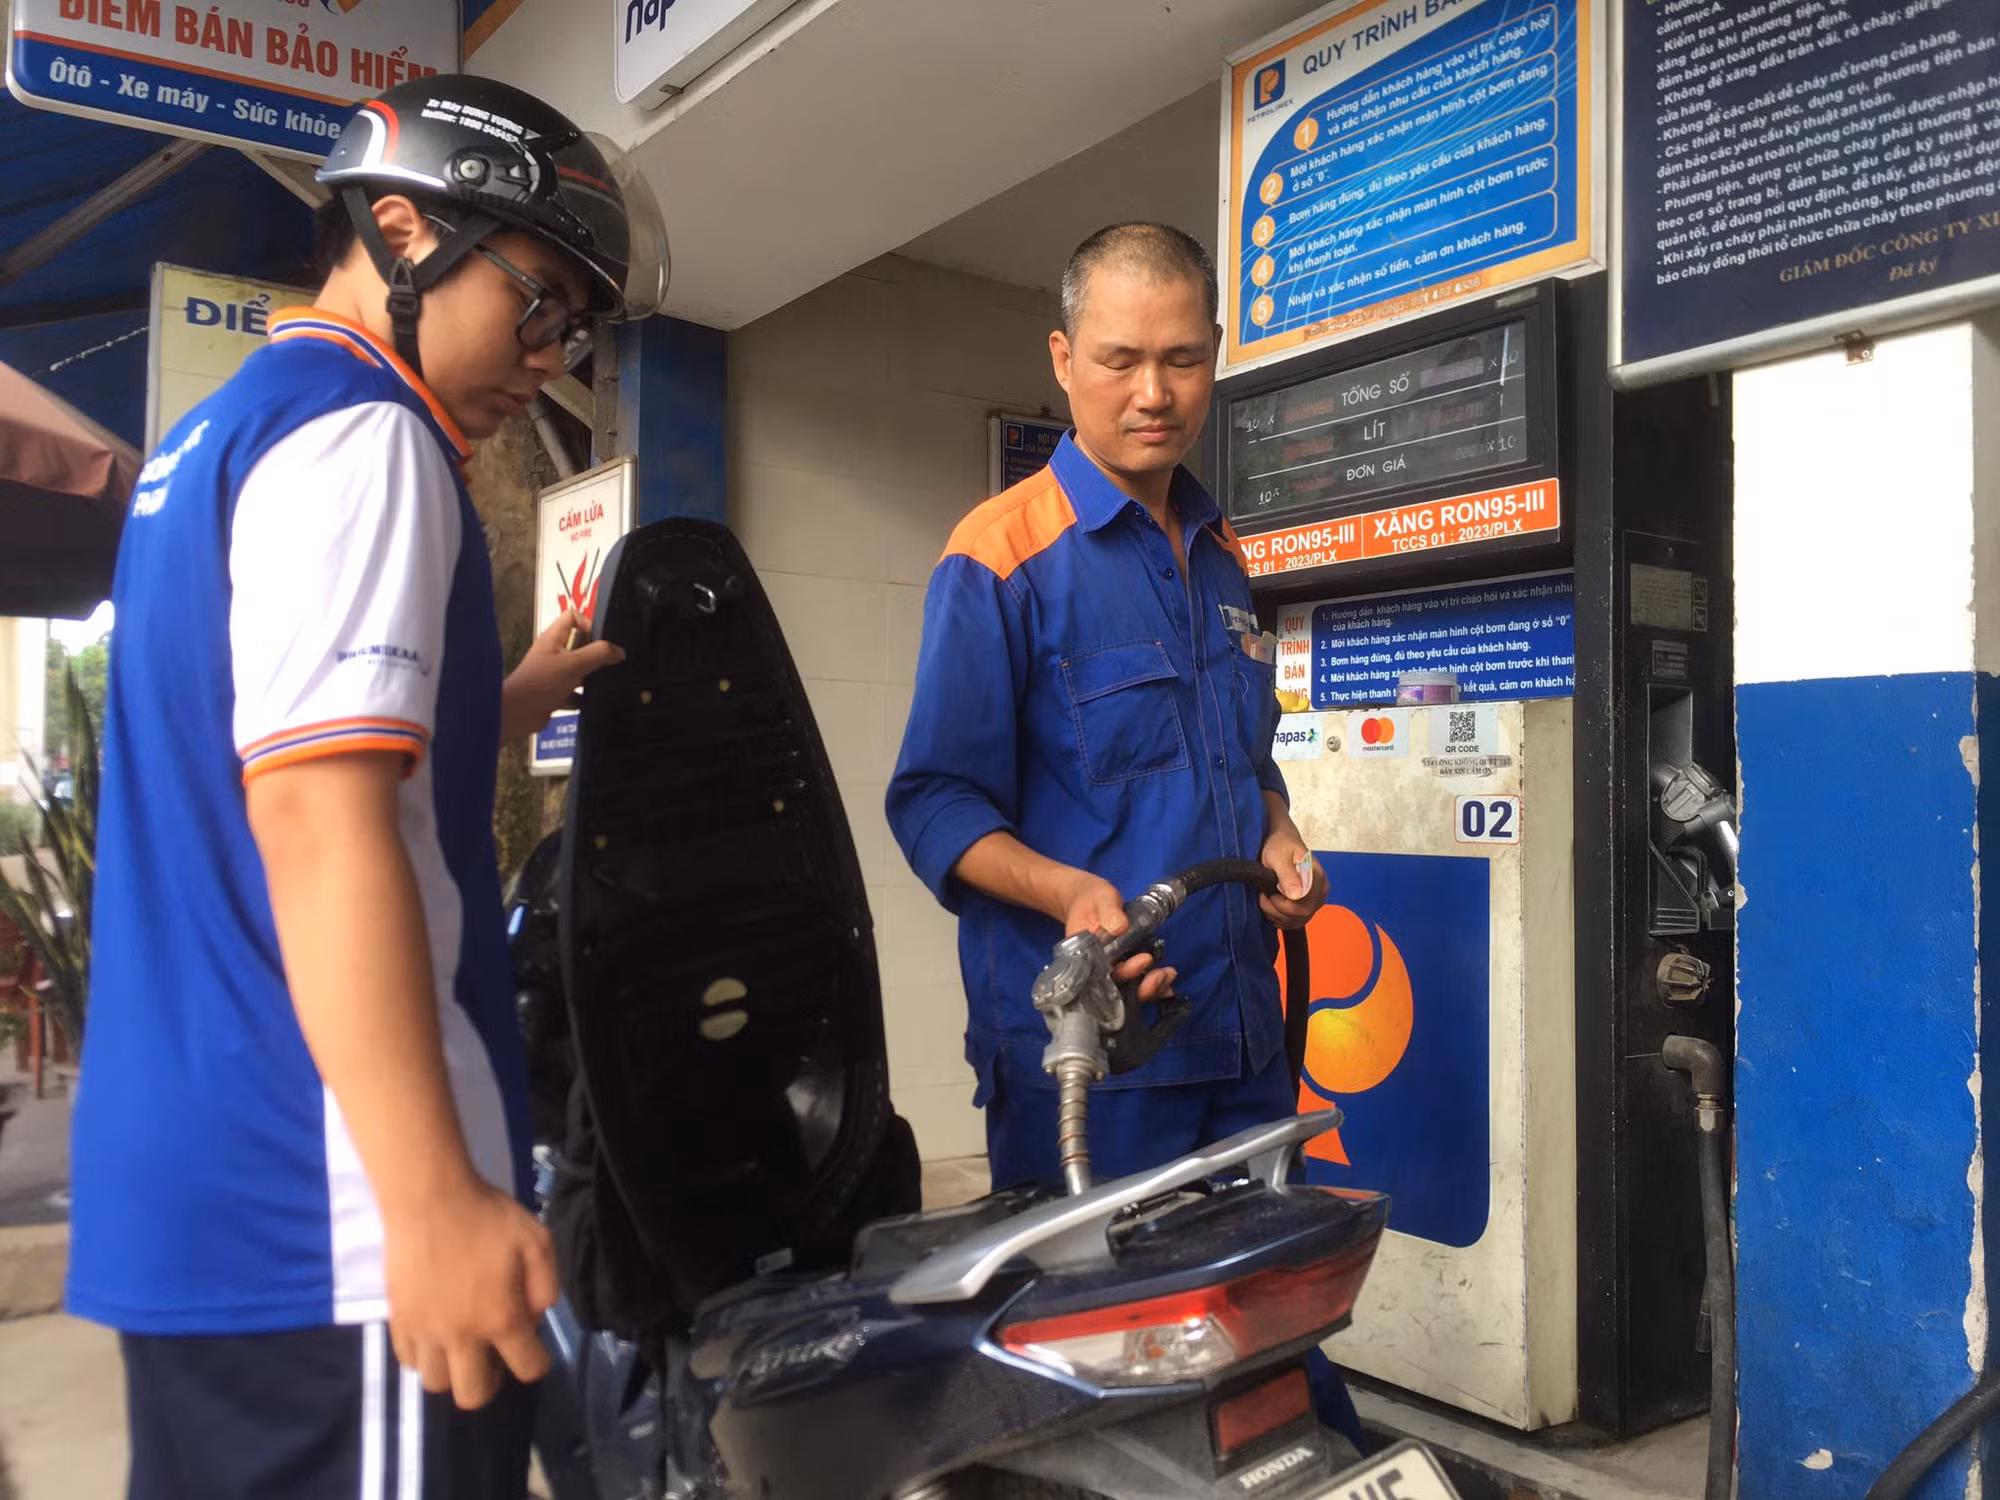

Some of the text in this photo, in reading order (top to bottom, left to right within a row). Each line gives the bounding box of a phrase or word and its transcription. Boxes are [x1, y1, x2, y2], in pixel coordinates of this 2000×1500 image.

[175, 5, 253, 58] BÁN
[267, 23, 338, 78] BẢO
[1303, 39, 1346, 75] QUY
[1352, 5, 1417, 51] TRÌNH
[50, 57, 92, 88] Ôtô
[117, 74, 148, 98] Xe
[157, 87, 209, 113] máy
[233, 98, 278, 126] Sức
[1247, 98, 1294, 124] PETROLIMEX
[1303, 123, 1310, 145] 1
[1265, 179, 1277, 201] 2
[1787, 194, 1813, 212] quy
[1900, 199, 1933, 217] theo
[1257, 220, 1269, 242] 3
[1663, 250, 1684, 266] Khi
[1710, 241, 1723, 252] ra
[1789, 208, 1832, 229] nhanh
[1944, 218, 1971, 239] TY
[1307, 233, 1336, 253] khách
[1457, 230, 1491, 251] khách
[1256, 261, 1268, 280] 4
[1305, 250, 1332, 269] thanh
[184, 293, 271, 337] ĐIỂ
[1256, 302, 1268, 322] 5
[1341, 371, 1410, 406] TỔNG SỐ
[1363, 418, 1386, 441] LÍT
[1346, 453, 1407, 481] ĐƠN GIÁ
[559, 499, 604, 531] CẤM LỬA
[1373, 488, 1545, 539] XĂNG RON95-III
[570, 527, 592, 542] NO FIRE
[1241, 523, 1355, 560] NG RON95-III
[1392, 535, 1427, 552] TCCS
[1431, 532, 1446, 546] 01
[1458, 518, 1523, 541] 2023/PLX
[1263, 560, 1275, 573] 01
[1285, 549, 1337, 569] 2023/PLX
[1285, 616, 1305, 633] QUY
[1320, 641, 1328, 650] 2.
[1346, 635, 1369, 647] khách
[1470, 623, 1484, 637] cột
[1508, 620, 1530, 633] đang
[1280, 636, 1310, 656] TRÌNH
[1320, 658, 1328, 667] 3.
[1406, 648, 1425, 661] theo
[1478, 640, 1504, 653] khách
[1284, 660, 1305, 680] BÁN
[1273, 730, 1306, 746] napas
[1445, 745, 1480, 754] QR CODE
[1463, 800, 1512, 837] 02
[1238, 1447, 1314, 1489] HONDA
